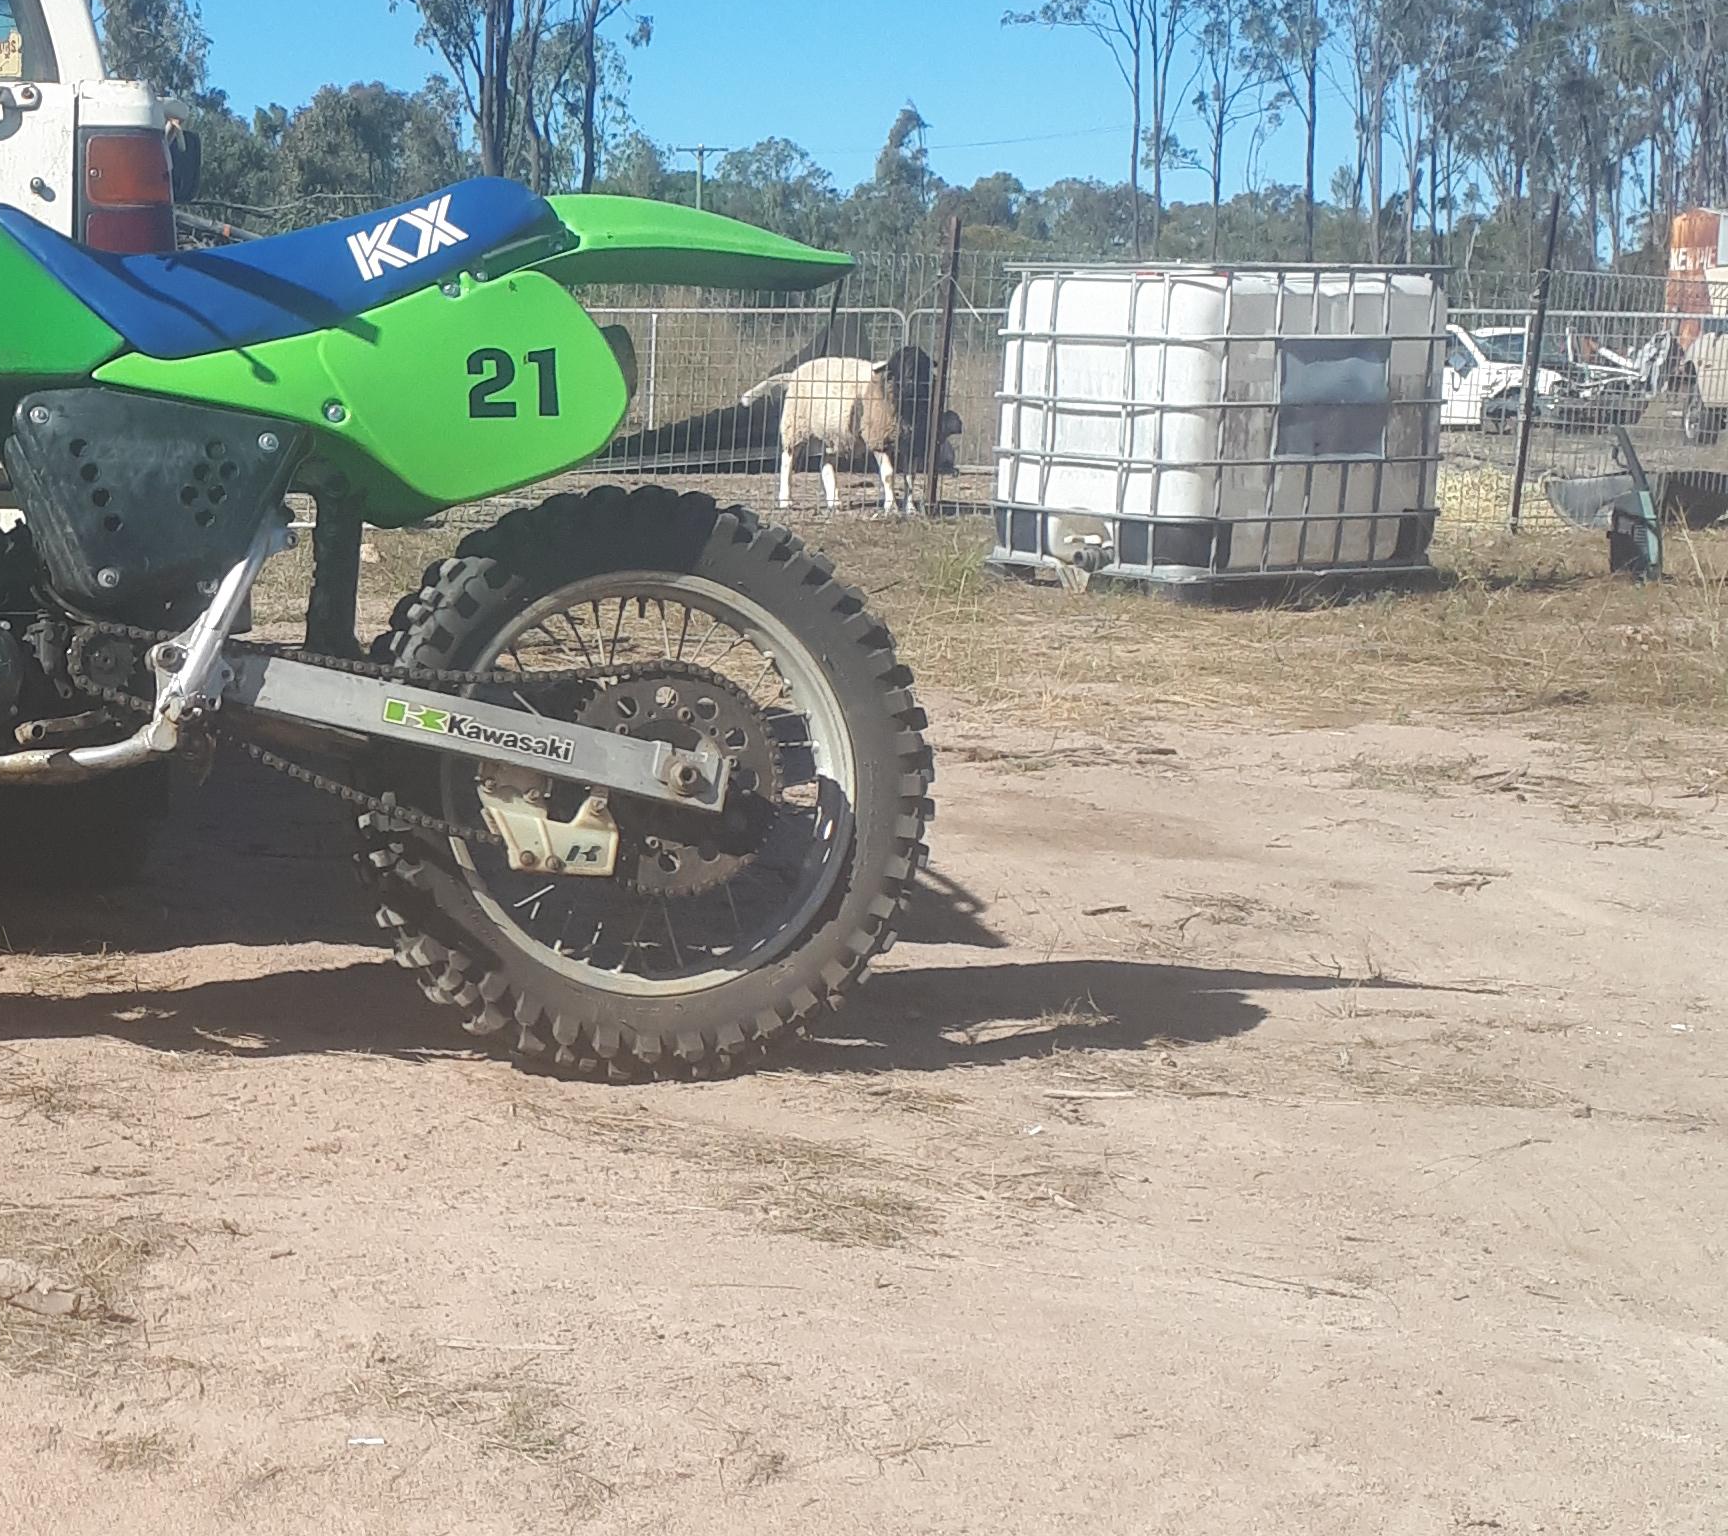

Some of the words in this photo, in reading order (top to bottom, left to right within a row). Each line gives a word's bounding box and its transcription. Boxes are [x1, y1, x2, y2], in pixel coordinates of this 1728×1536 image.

[346, 193, 470, 282] KX
[466, 347, 560, 419] 21
[447, 714, 573, 762] Kawasaki
